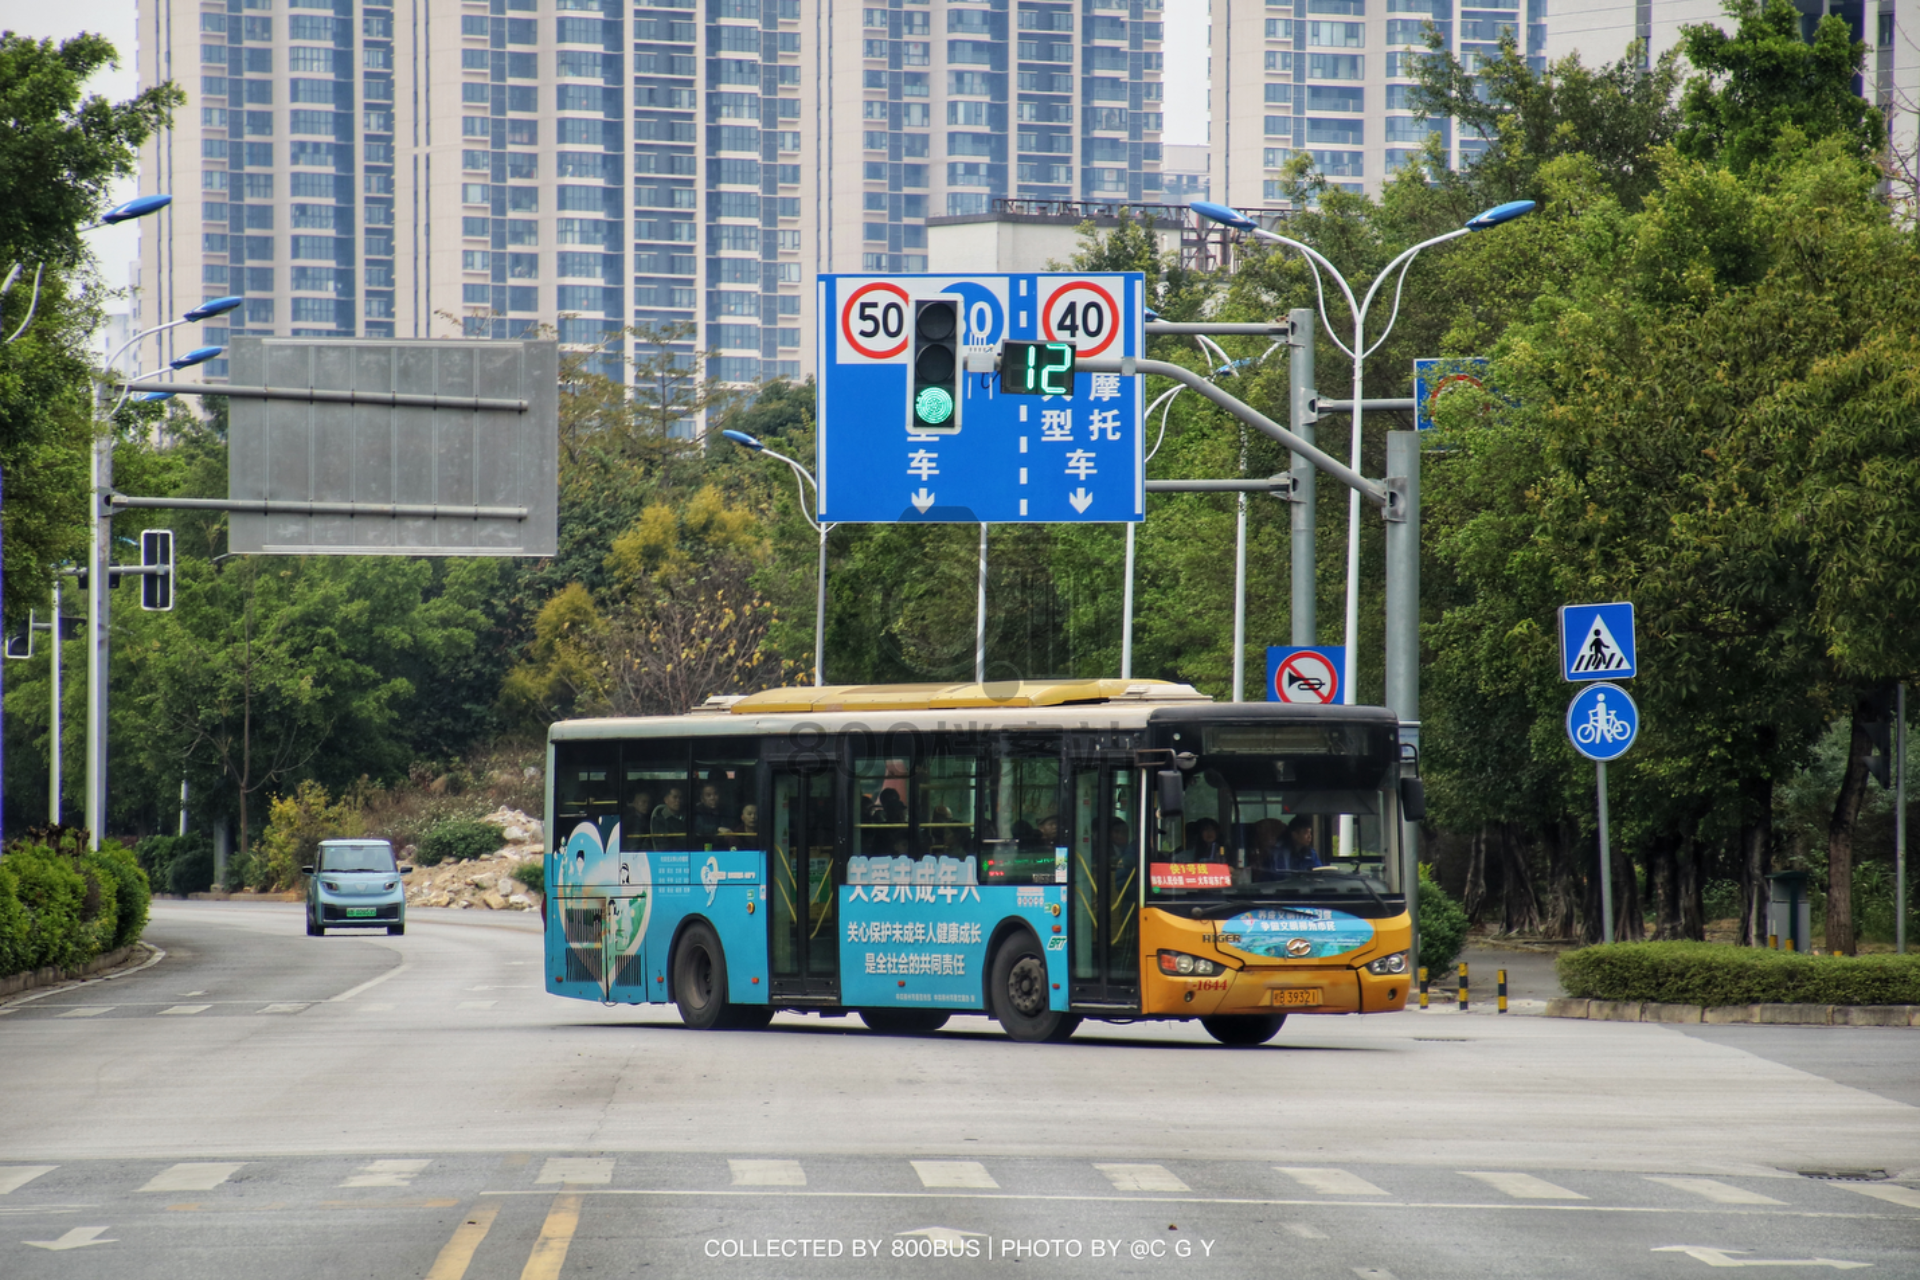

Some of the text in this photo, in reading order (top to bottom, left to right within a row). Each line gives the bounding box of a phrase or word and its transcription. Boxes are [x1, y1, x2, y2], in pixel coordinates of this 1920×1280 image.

[858, 301, 904, 338] 50
[963, 300, 993, 337] 0
[1056, 300, 1104, 338] 40
[1026, 343, 1072, 394] 12
[1064, 449, 1098, 481] 车
[849, 863, 981, 904] 关爱未成年人
[847, 921, 982, 944] 关心保护未成年人健康成长
[1202, 933, 1242, 943] HIGER
[865, 952, 965, 976] 是全社会的共同责任
